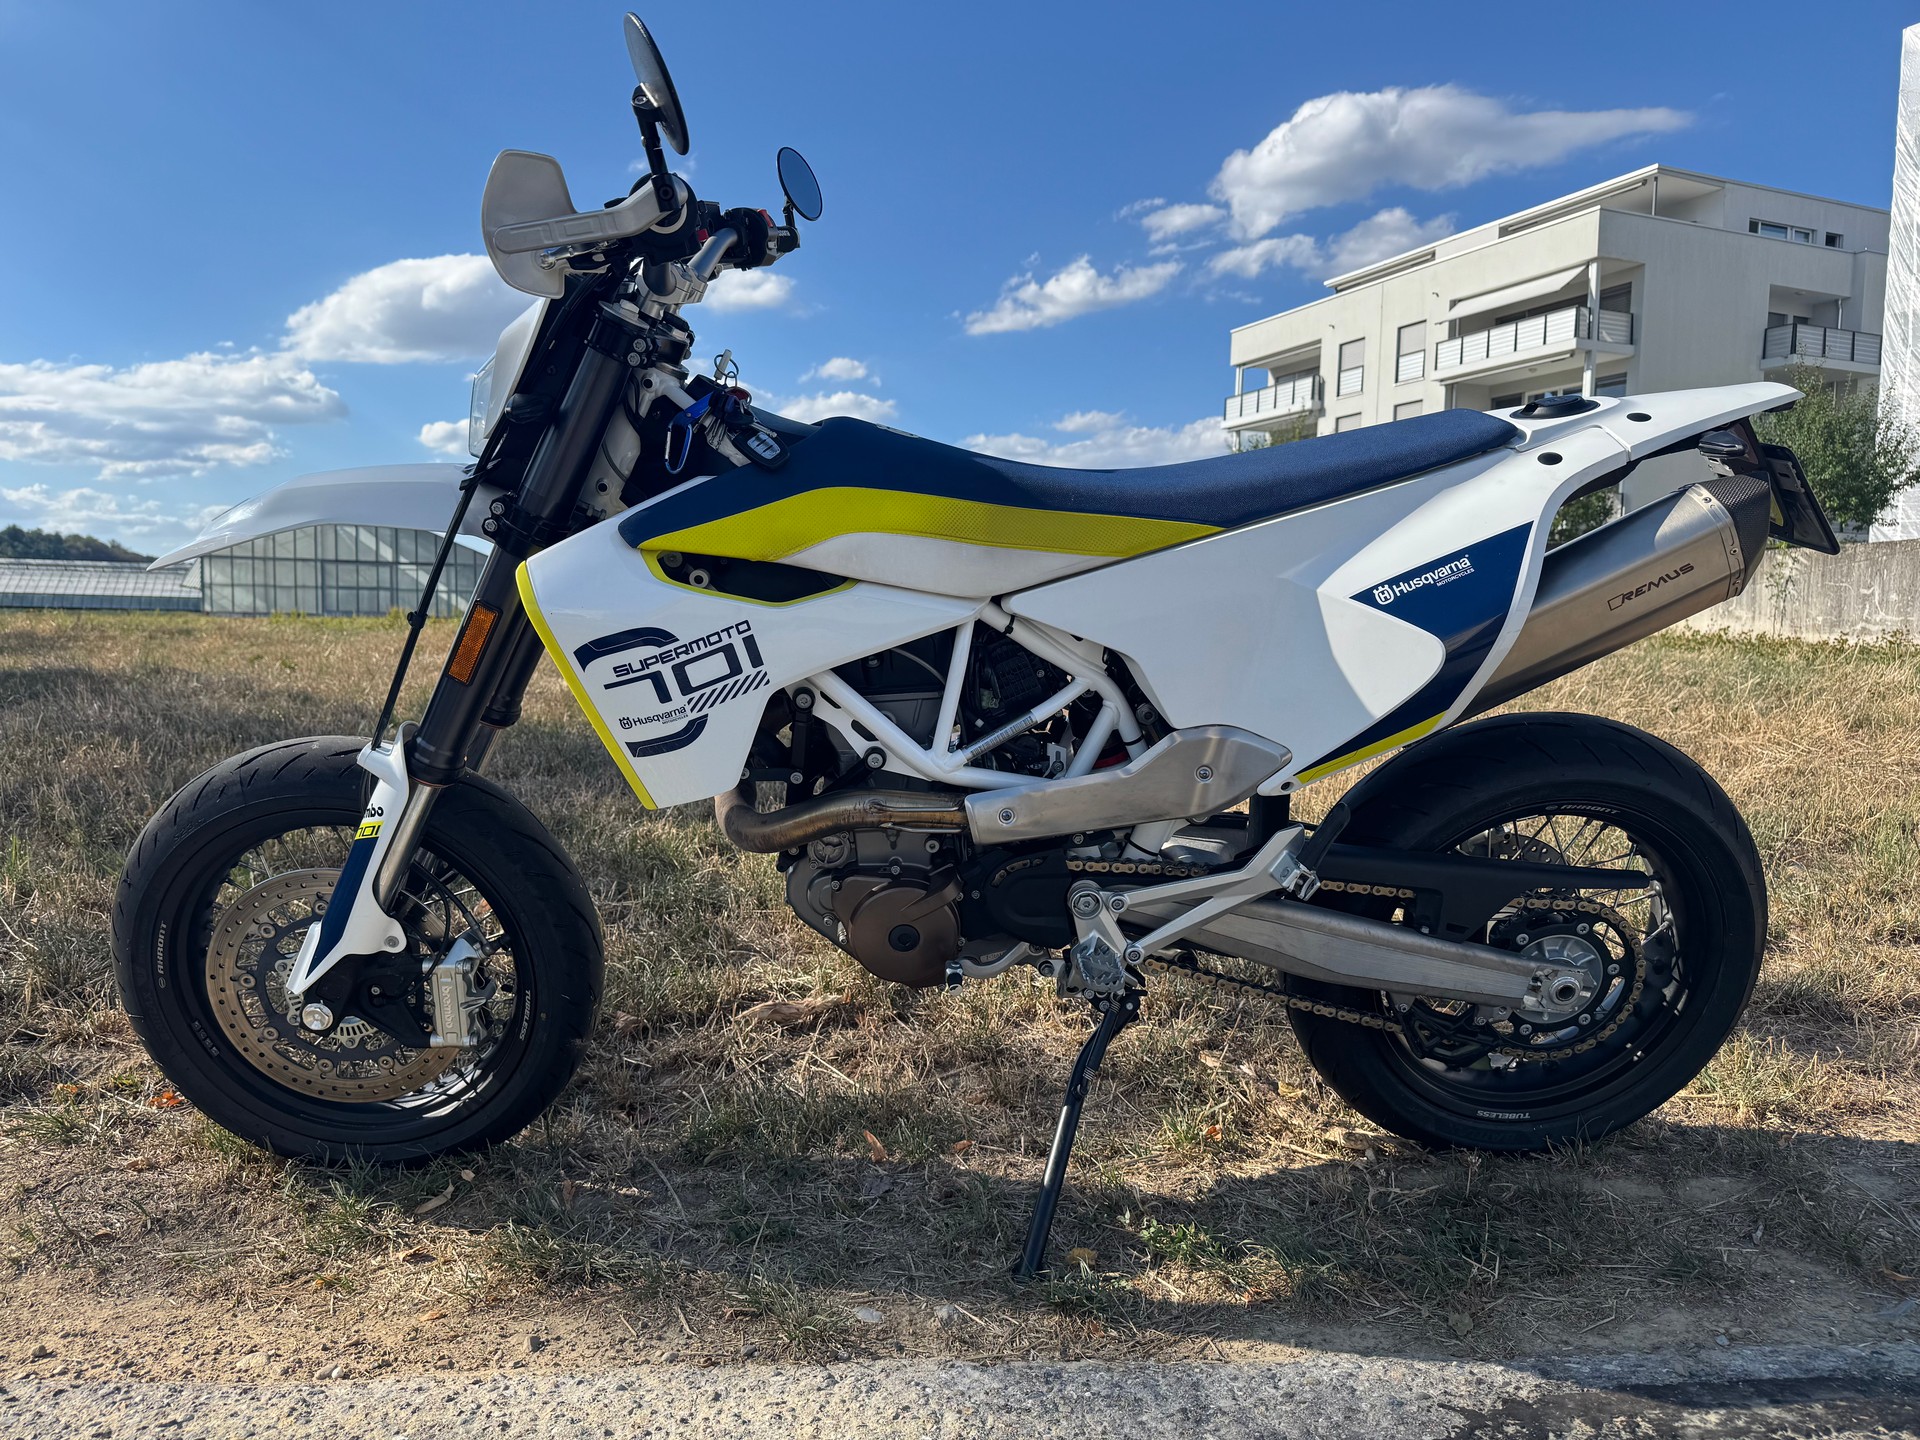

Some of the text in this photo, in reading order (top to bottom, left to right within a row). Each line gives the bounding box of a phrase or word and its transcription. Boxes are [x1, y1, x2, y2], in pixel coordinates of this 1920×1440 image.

[1393, 556, 1471, 597] Husqvarna
[1436, 568, 1475, 587] MOTORCYCLES
[1607, 563, 1695, 612] REMUS
[603, 633, 765, 705] 701
[612, 619, 752, 678] SUPERMOTO
[634, 705, 687, 727] Husqvarna
[519, 989, 531, 1041] TUBELESS
[1476, 1110, 1531, 1119] TUBELESS
